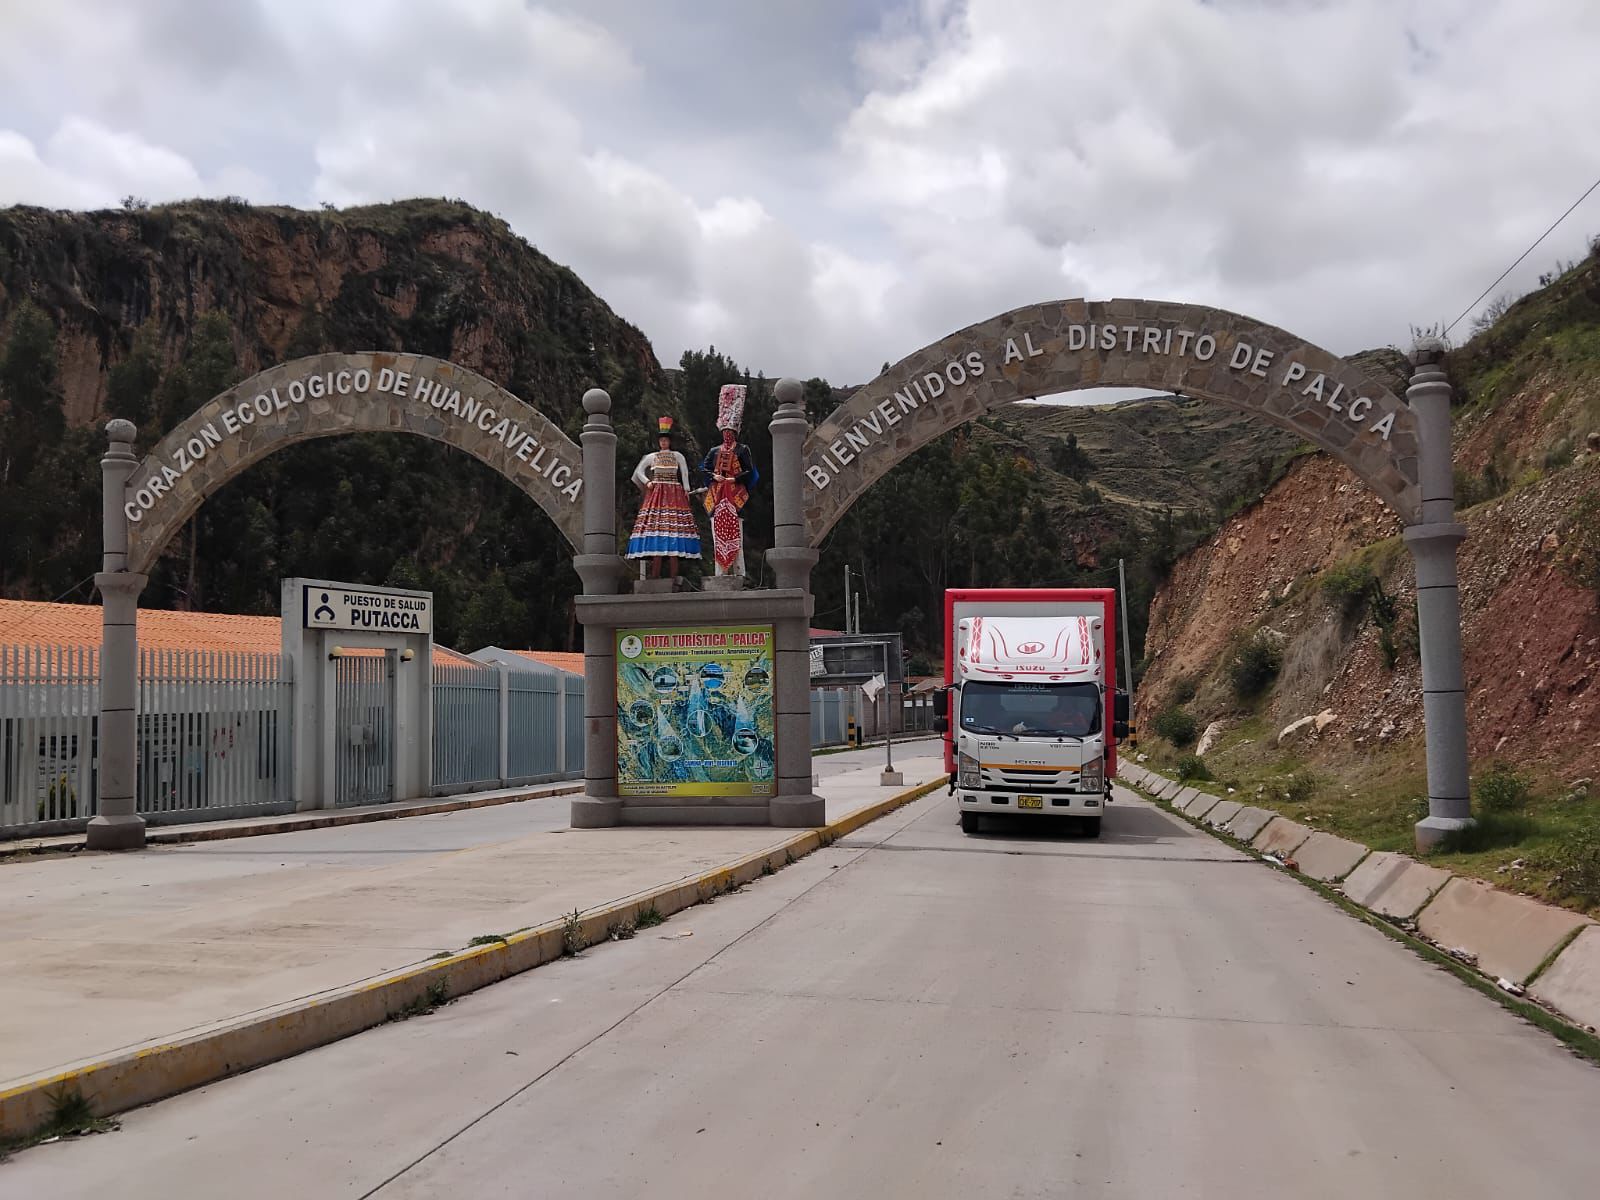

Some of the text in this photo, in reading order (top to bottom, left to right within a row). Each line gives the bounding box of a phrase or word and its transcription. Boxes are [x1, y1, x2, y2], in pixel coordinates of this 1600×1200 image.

[805, 324, 1397, 491] BIENVENIDOS AL DISTRITO DE PALCA
[124, 367, 586, 522] CORAZON ECOLOGICO DE HUANCAVELICA
[343, 594, 426, 611] PUESTO DE SALUD
[351, 609, 419, 629] PUTACCA
[644, 635, 670, 648] RUTA
[672, 632, 727, 647] TURÍSTICA
